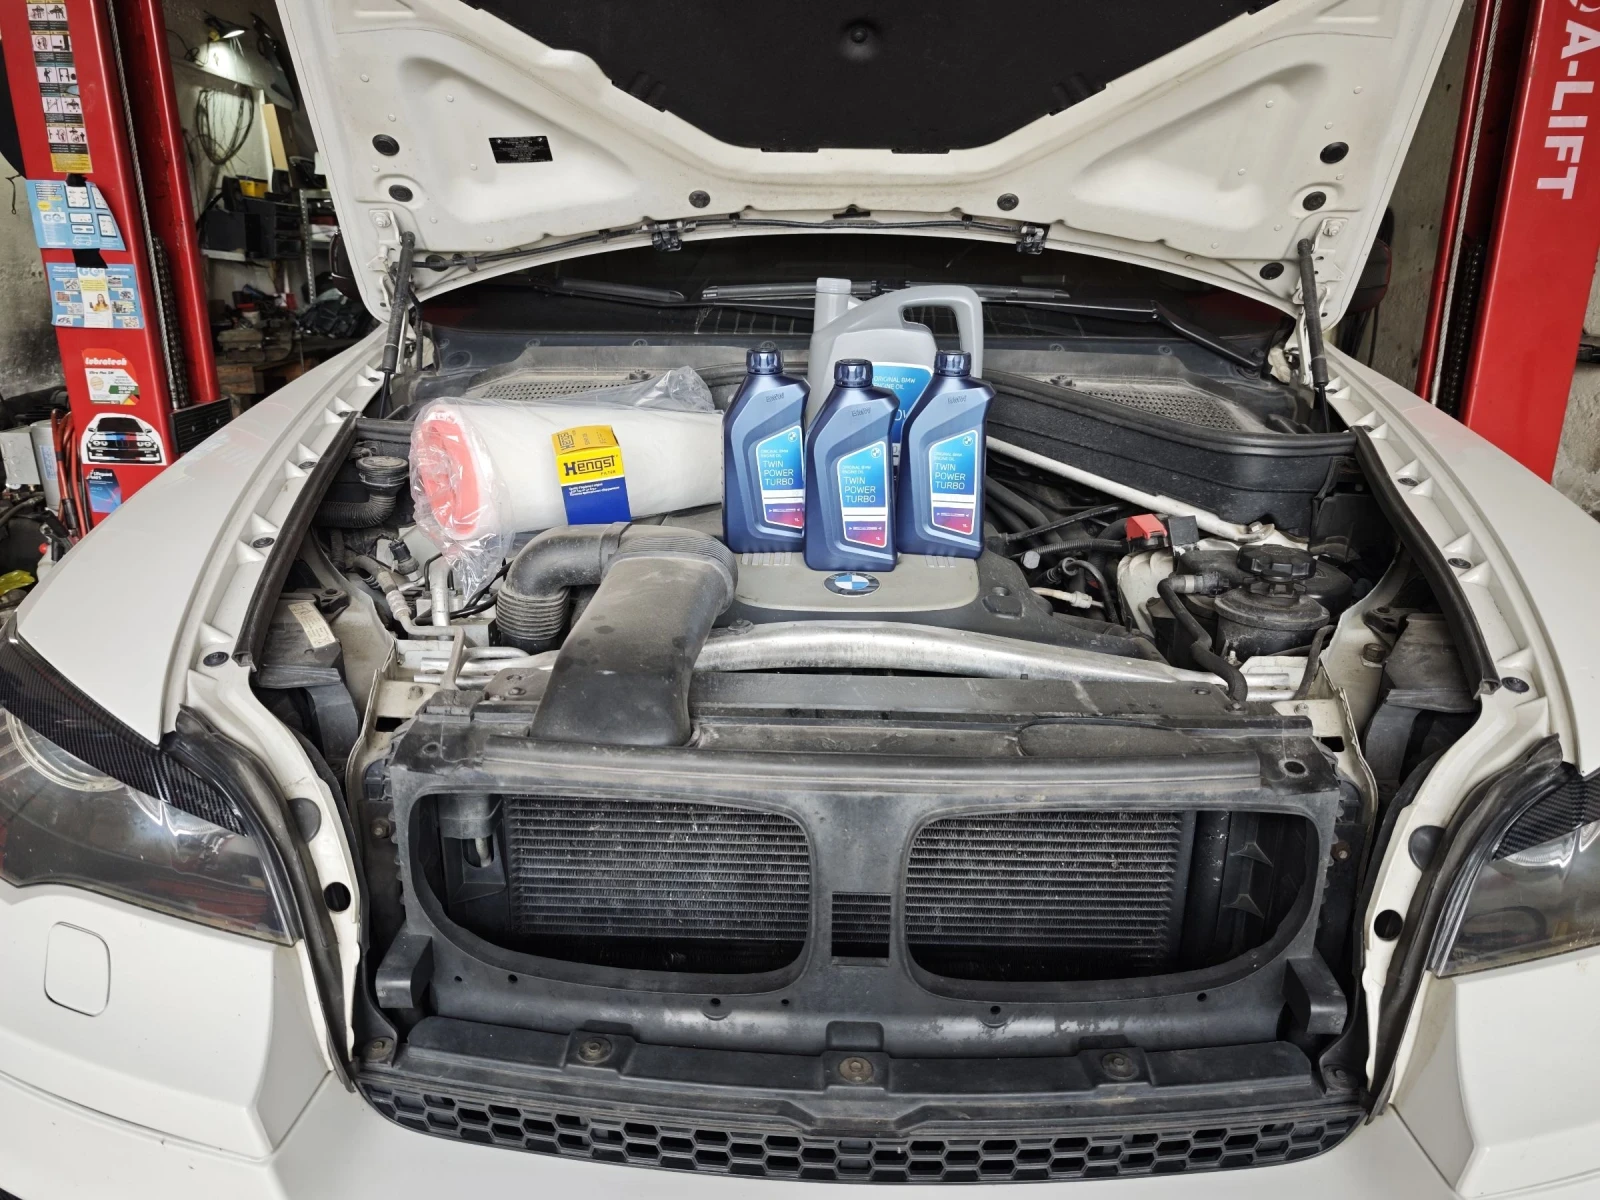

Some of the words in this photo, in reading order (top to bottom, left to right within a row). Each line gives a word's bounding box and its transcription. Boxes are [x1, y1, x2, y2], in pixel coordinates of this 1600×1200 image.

[1537, 0, 1600, 200] A-LIFT
[873, 375, 900, 383] ORIGINAL
[563, 455, 615, 477] Hengst
[763, 460, 784, 468] TWIN
[934, 463, 956, 471] TWIN
[764, 469, 794, 477] POWER
[934, 472, 966, 481] POWER
[765, 478, 794, 486] TURBO
[843, 477, 866, 485] TWIN
[935, 481, 965, 490] TURBO
[844, 486, 876, 494] POWER
[845, 495, 876, 503] TURBO
